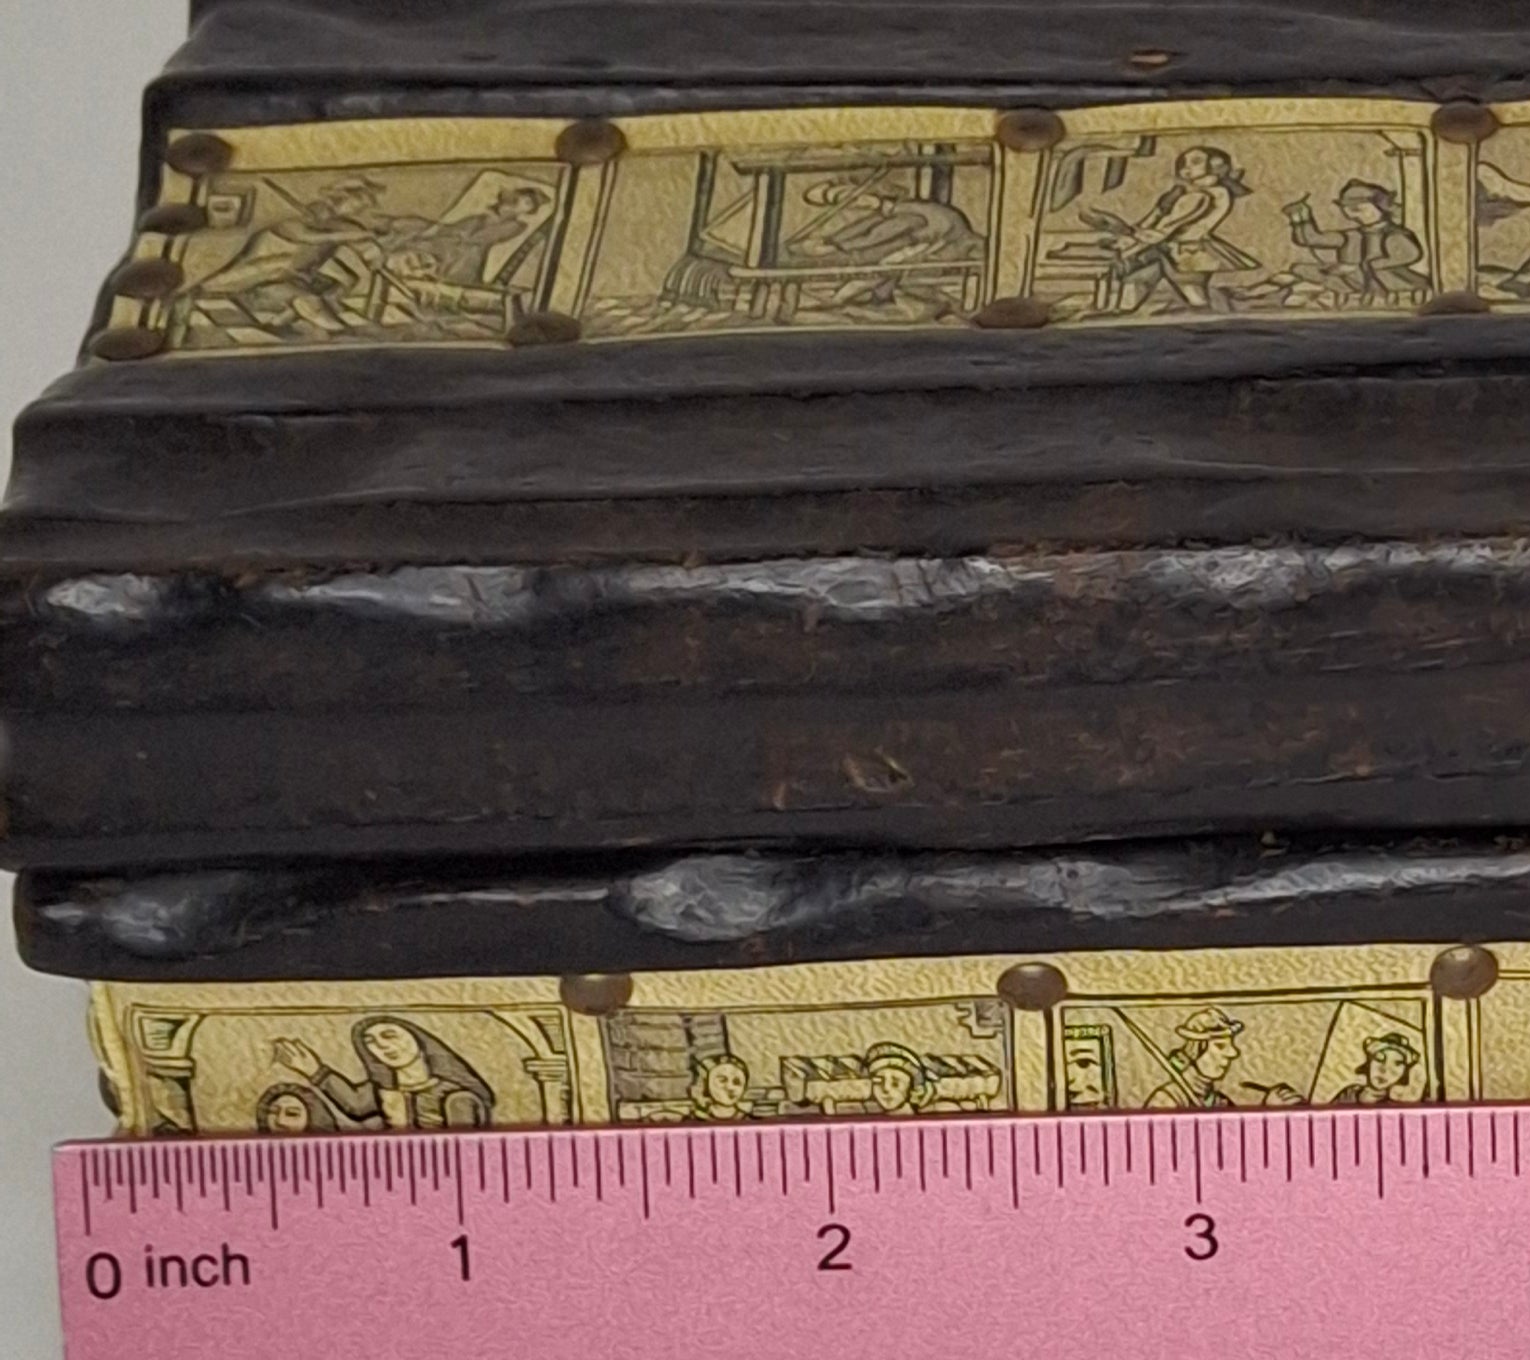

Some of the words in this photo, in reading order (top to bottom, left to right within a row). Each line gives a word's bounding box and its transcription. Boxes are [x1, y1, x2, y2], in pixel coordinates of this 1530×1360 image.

[85, 1252, 122, 1300] 0
[145, 1242, 251, 1288] inch
[450, 1234, 471, 1282] 1
[816, 1223, 853, 1272] 2
[1184, 1212, 1219, 1261] 3
